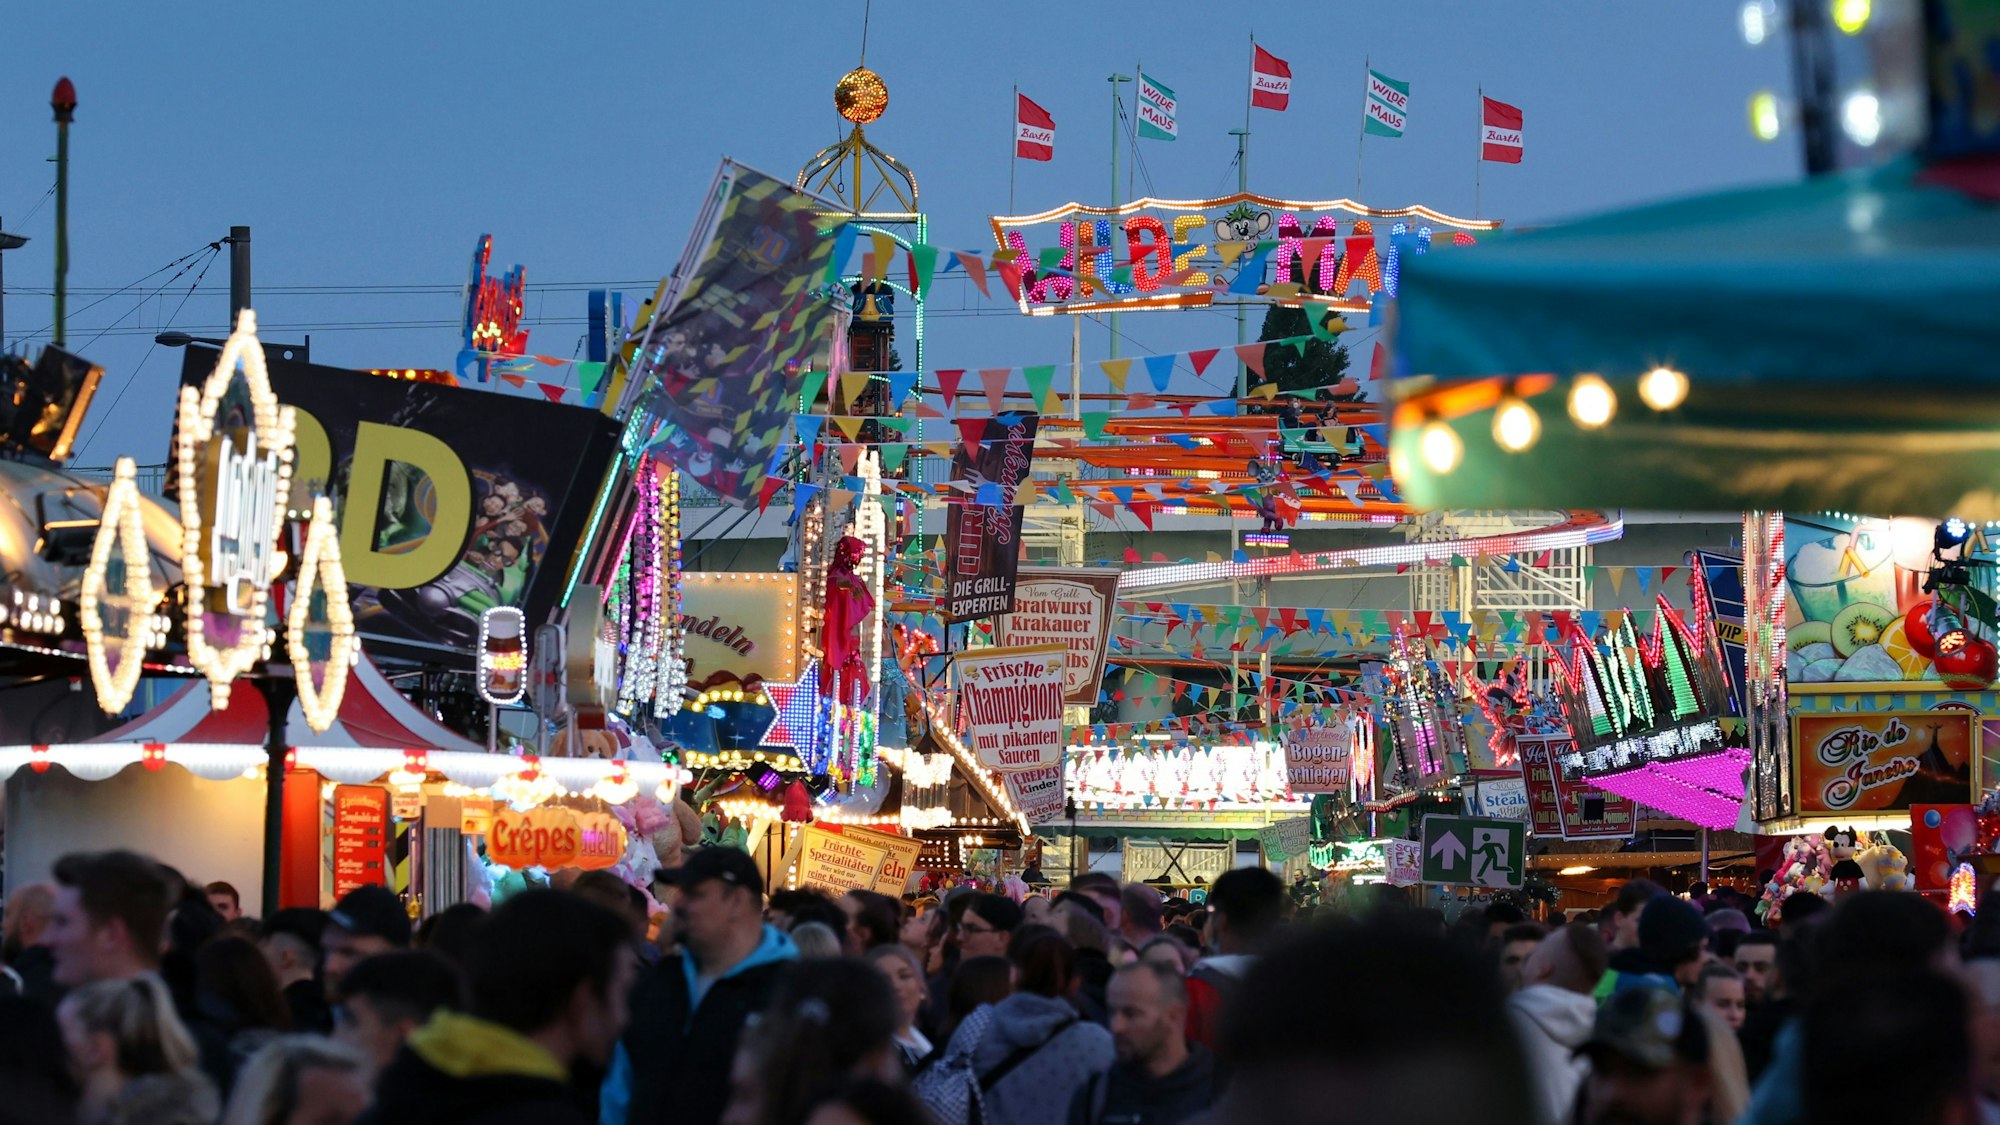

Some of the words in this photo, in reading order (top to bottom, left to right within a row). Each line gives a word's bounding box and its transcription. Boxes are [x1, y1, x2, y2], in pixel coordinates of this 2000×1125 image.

[1256, 77, 1288, 90] Barth
[1372, 79, 1407, 107] WILDE
[1143, 83, 1174, 111] WILDE
[1142, 106, 1173, 131] MAUS
[1370, 103, 1402, 127] MAUS
[1020, 128, 1051, 143] Barth
[1486, 130, 1520, 143] Barth
[1008, 214, 1209, 304] WILDE
[953, 580, 972, 598] DIE
[974, 576, 1011, 594] GRILL-
[1025, 586, 1048, 597] Vom
[951, 595, 1009, 617] EXPERTEN
[1014, 599, 1092, 615] Bratwurst
[1011, 616, 1091, 632] Krakauer
[1718, 622, 1742, 640] VIP
[981, 661, 1044, 683] Frische
[964, 679, 1063, 729] Champignons
[978, 732, 999, 749] mit
[1002, 730, 1058, 750] pikanten
[1819, 726, 1881, 765] Rio
[998, 749, 1040, 765] Saucen
[1289, 743, 1348, 765] Bogen-
[1013, 766, 1059, 785] CREPES
[1288, 765, 1347, 786] schießen
[1825, 758, 1918, 807] Janeiro
[492, 816, 576, 863] Crêpes
[823, 838, 866, 858] Früchte-
[809, 848, 874, 874] Spezialitäten
[820, 864, 832, 873] Hier
[833, 866, 845, 876] wird
[846, 871, 856, 879] nur
[808, 869, 827, 880] reine
[829, 874, 865, 889] Kuvertüre
